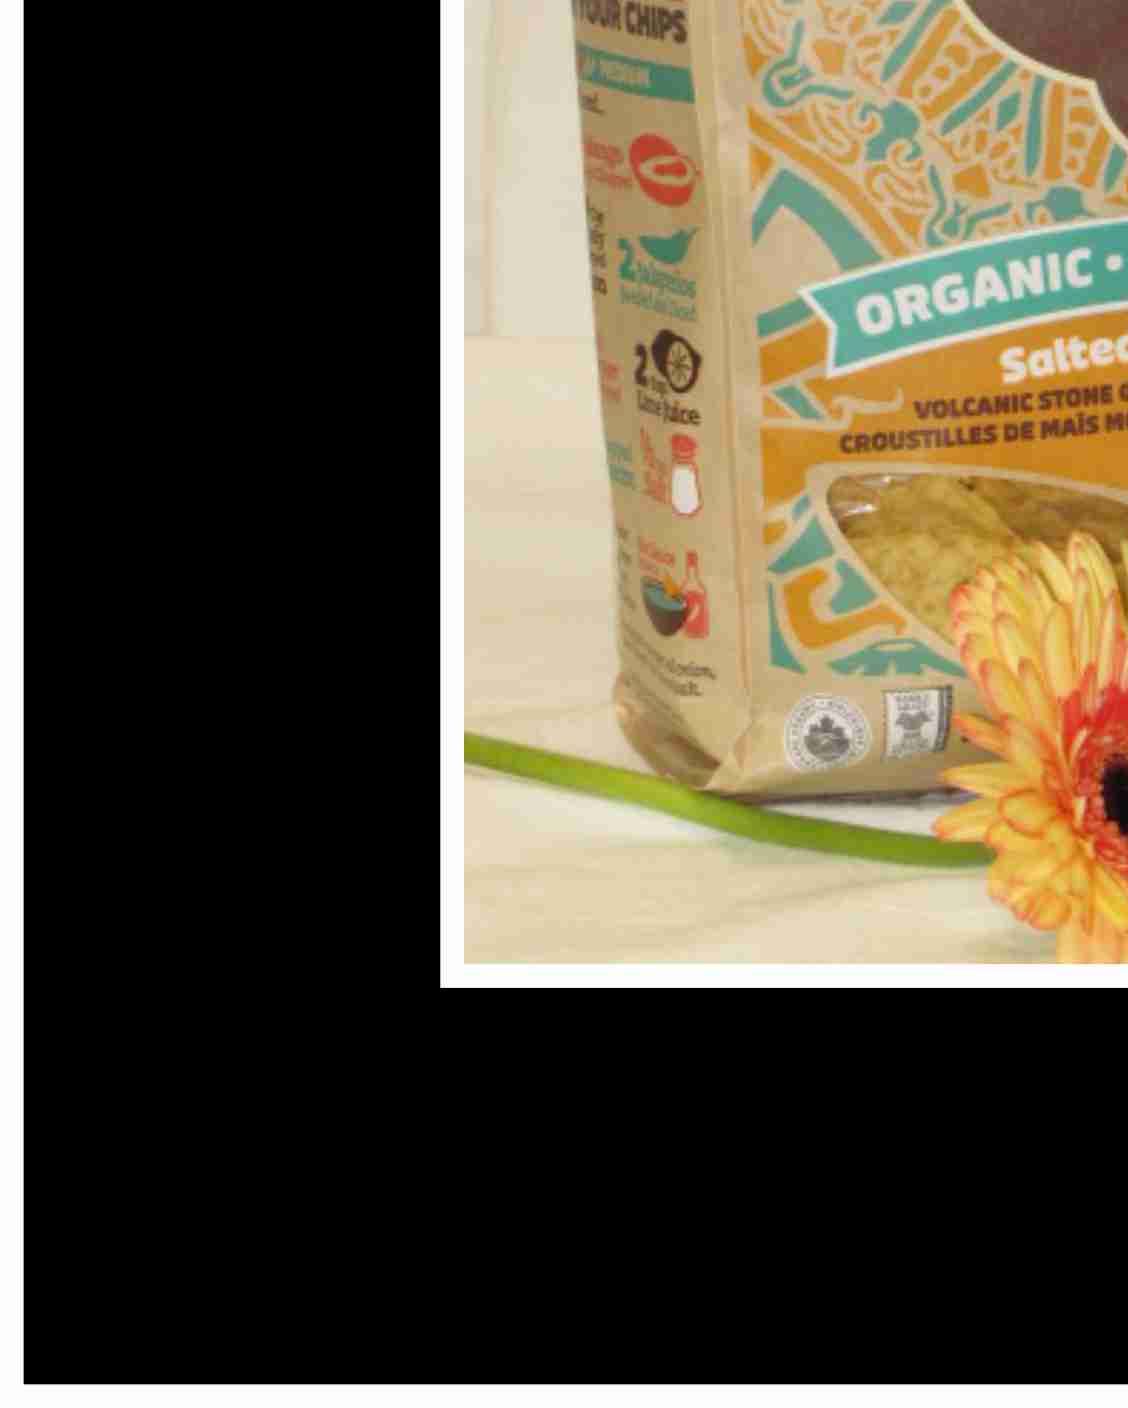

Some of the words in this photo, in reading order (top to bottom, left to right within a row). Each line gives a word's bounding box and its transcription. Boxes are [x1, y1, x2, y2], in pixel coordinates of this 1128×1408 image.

[625, 1, 687, 44] CHIPS
[616, 238, 634, 280] 2
[855, 247, 1094, 335] ORGANIC
[634, 343, 648, 386] 2
[913, 392, 1034, 421] VOLCANIC
[1038, 384, 1113, 410] STONE
[839, 423, 998, 454] CROUSTILLES
[1002, 421, 1037, 443] DE
